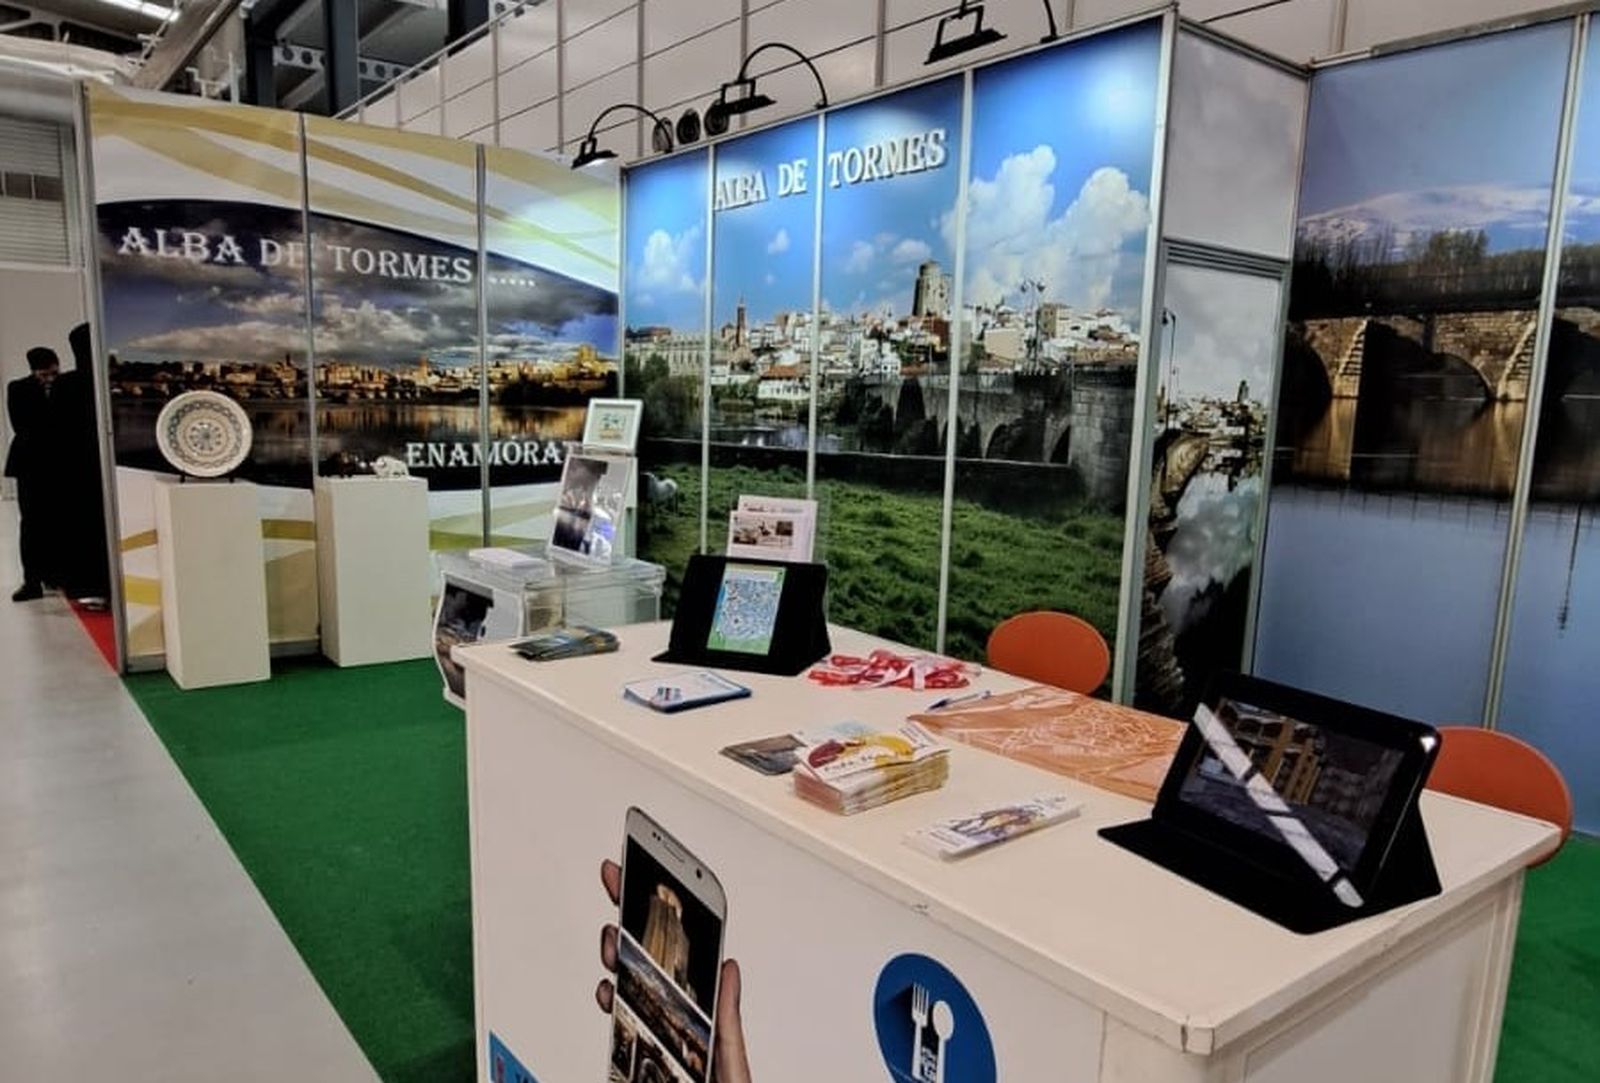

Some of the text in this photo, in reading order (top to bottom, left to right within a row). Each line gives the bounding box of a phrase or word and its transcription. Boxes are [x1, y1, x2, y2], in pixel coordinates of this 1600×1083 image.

[714, 127, 947, 210] ALBA DE TORMES
[117, 226, 247, 264] ALBA
[259, 238, 316, 270] DE
[326, 245, 473, 284] TORMES
